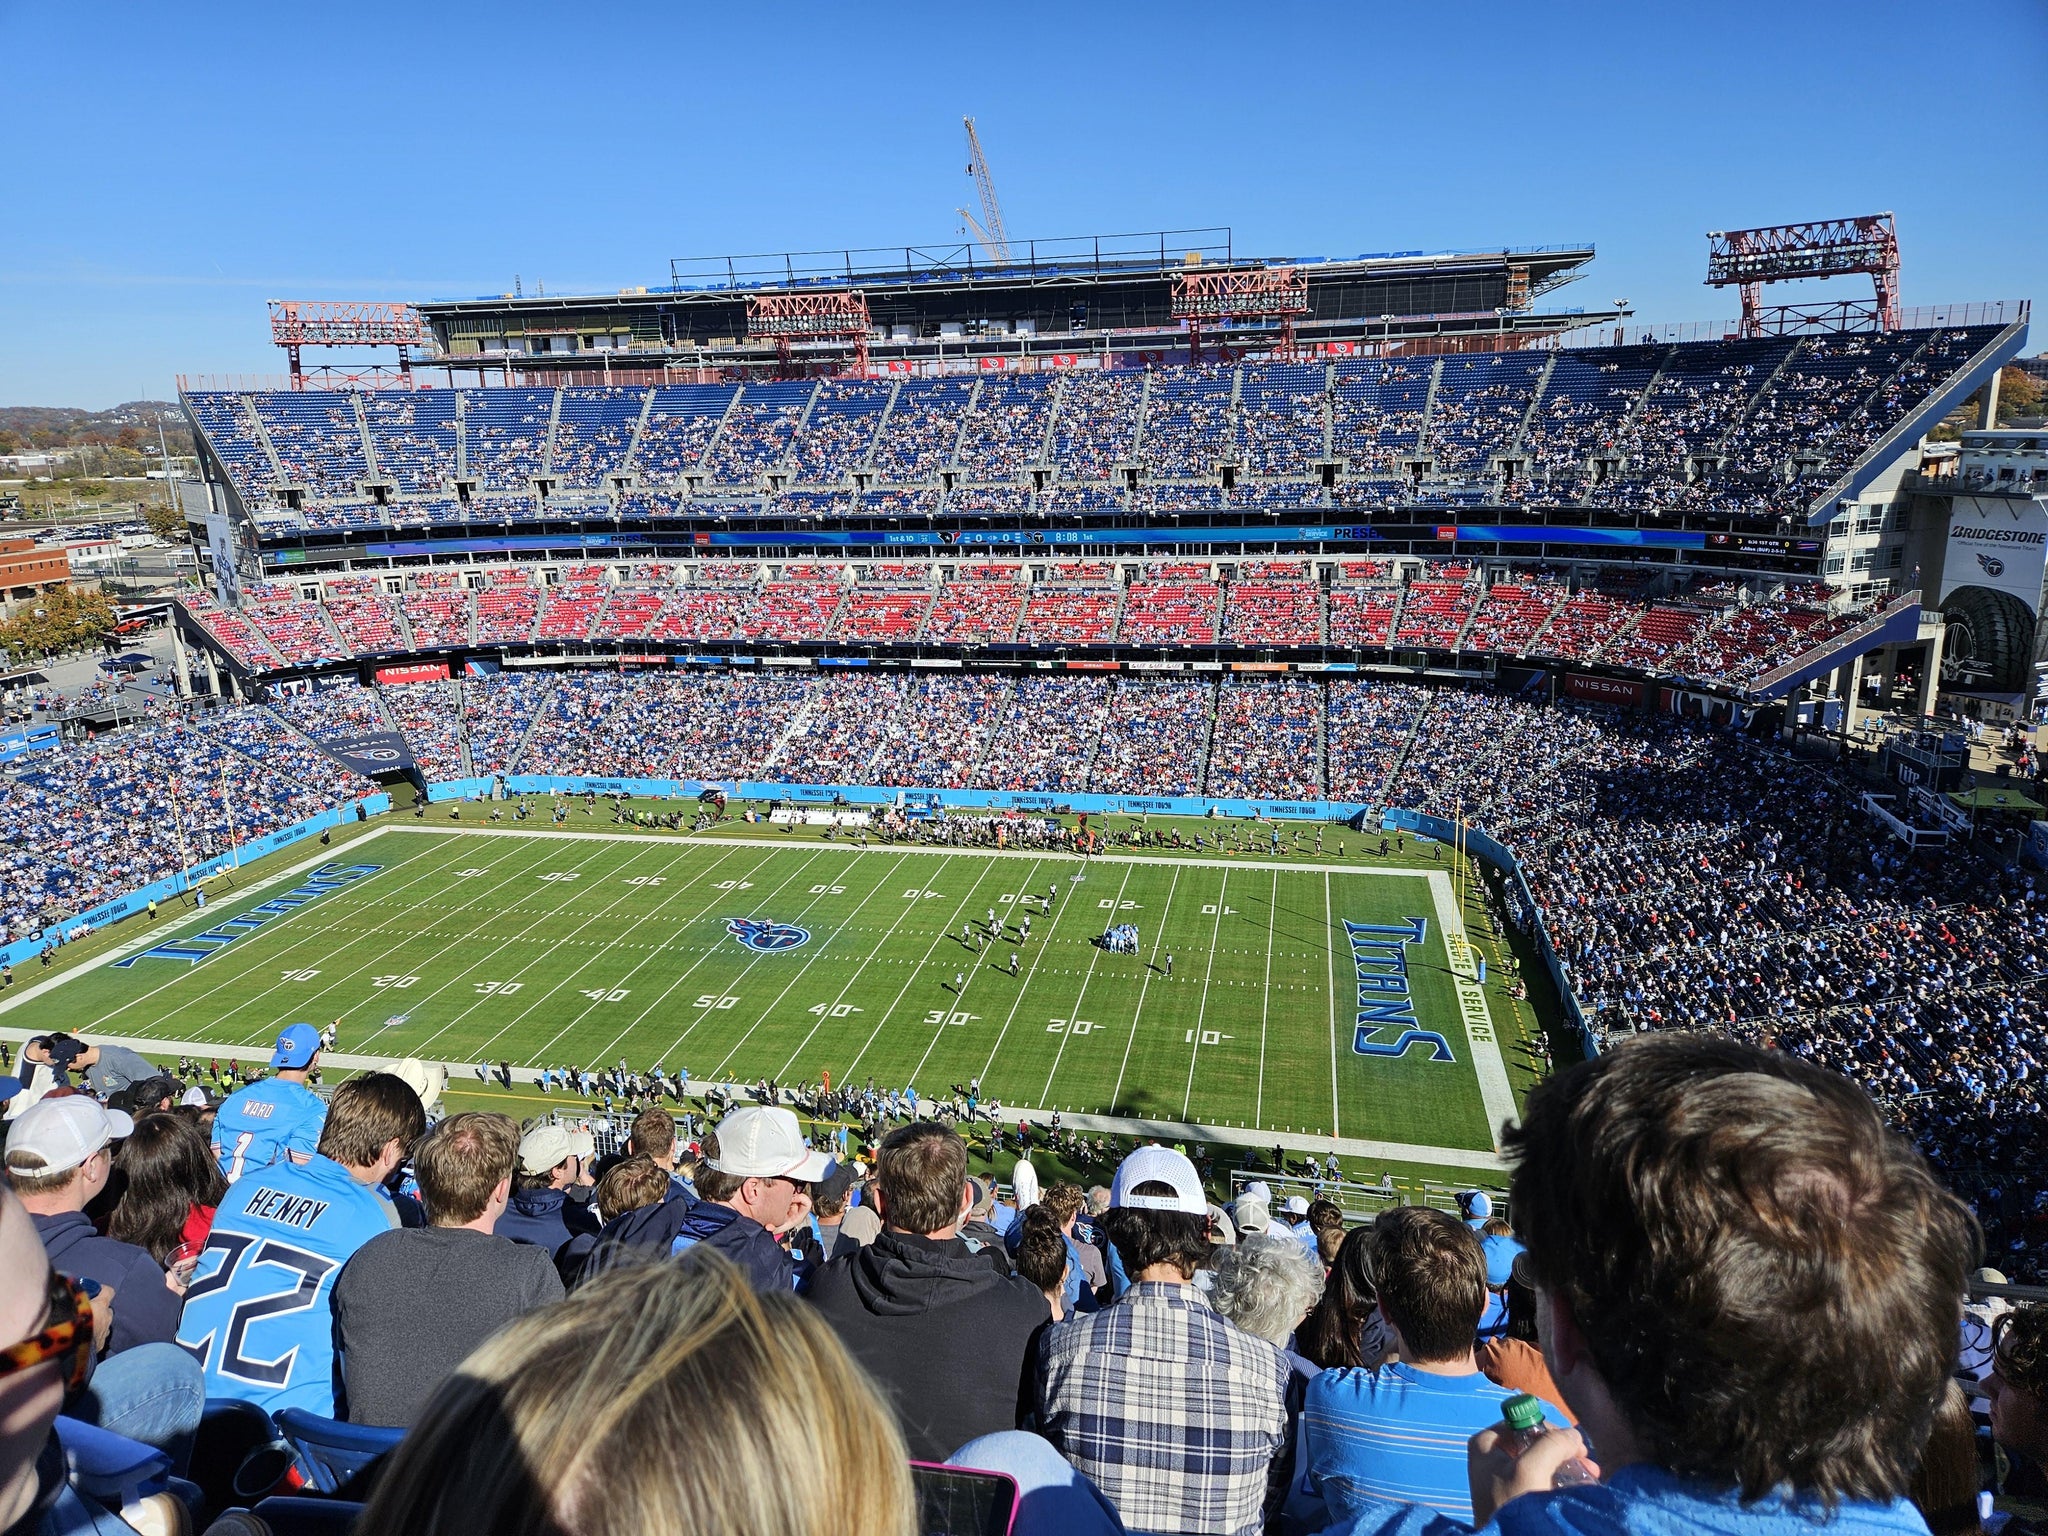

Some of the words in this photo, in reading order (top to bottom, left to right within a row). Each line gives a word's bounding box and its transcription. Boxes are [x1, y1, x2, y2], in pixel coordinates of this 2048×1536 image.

[975, 534, 983, 542] 0
[1002, 533, 1010, 542] 0
[1055, 532, 1078, 541] 8:08
[1951, 526, 2047, 544] BRIDGESTONE
[384, 665, 440, 676] NISSAN
[1574, 679, 1634, 696] NISSAN
[332, 739, 390, 751] NISSAN
[370, 765, 400, 775] NISSAN
[800, 789, 824, 797] TENNESSEE
[1127, 800, 1154, 809] TENNESSEE
[1269, 805, 1297, 814] TENNESSEE
[109, 862, 385, 969] TITANS
[284, 969, 322, 981] 10
[374, 975, 421, 988] 20
[475, 981, 525, 995] 30
[585, 988, 632, 1002] 40
[1341, 916, 1457, 1063] TITANS
[692, 995, 741, 1010] 50
[807, 1002, 855, 1018] 40
[923, 1010, 972, 1026] 30
[1461, 991, 1493, 1042] SERVICE
[1046, 1018, 1094, 1035] 20
[1185, 1029, 1221, 1045] 10
[241, 1099, 275, 1119] WARD
[227, 1131, 254, 1184] 1
[243, 1186, 328, 1232] HENRY
[175, 1229, 341, 1389] 22
